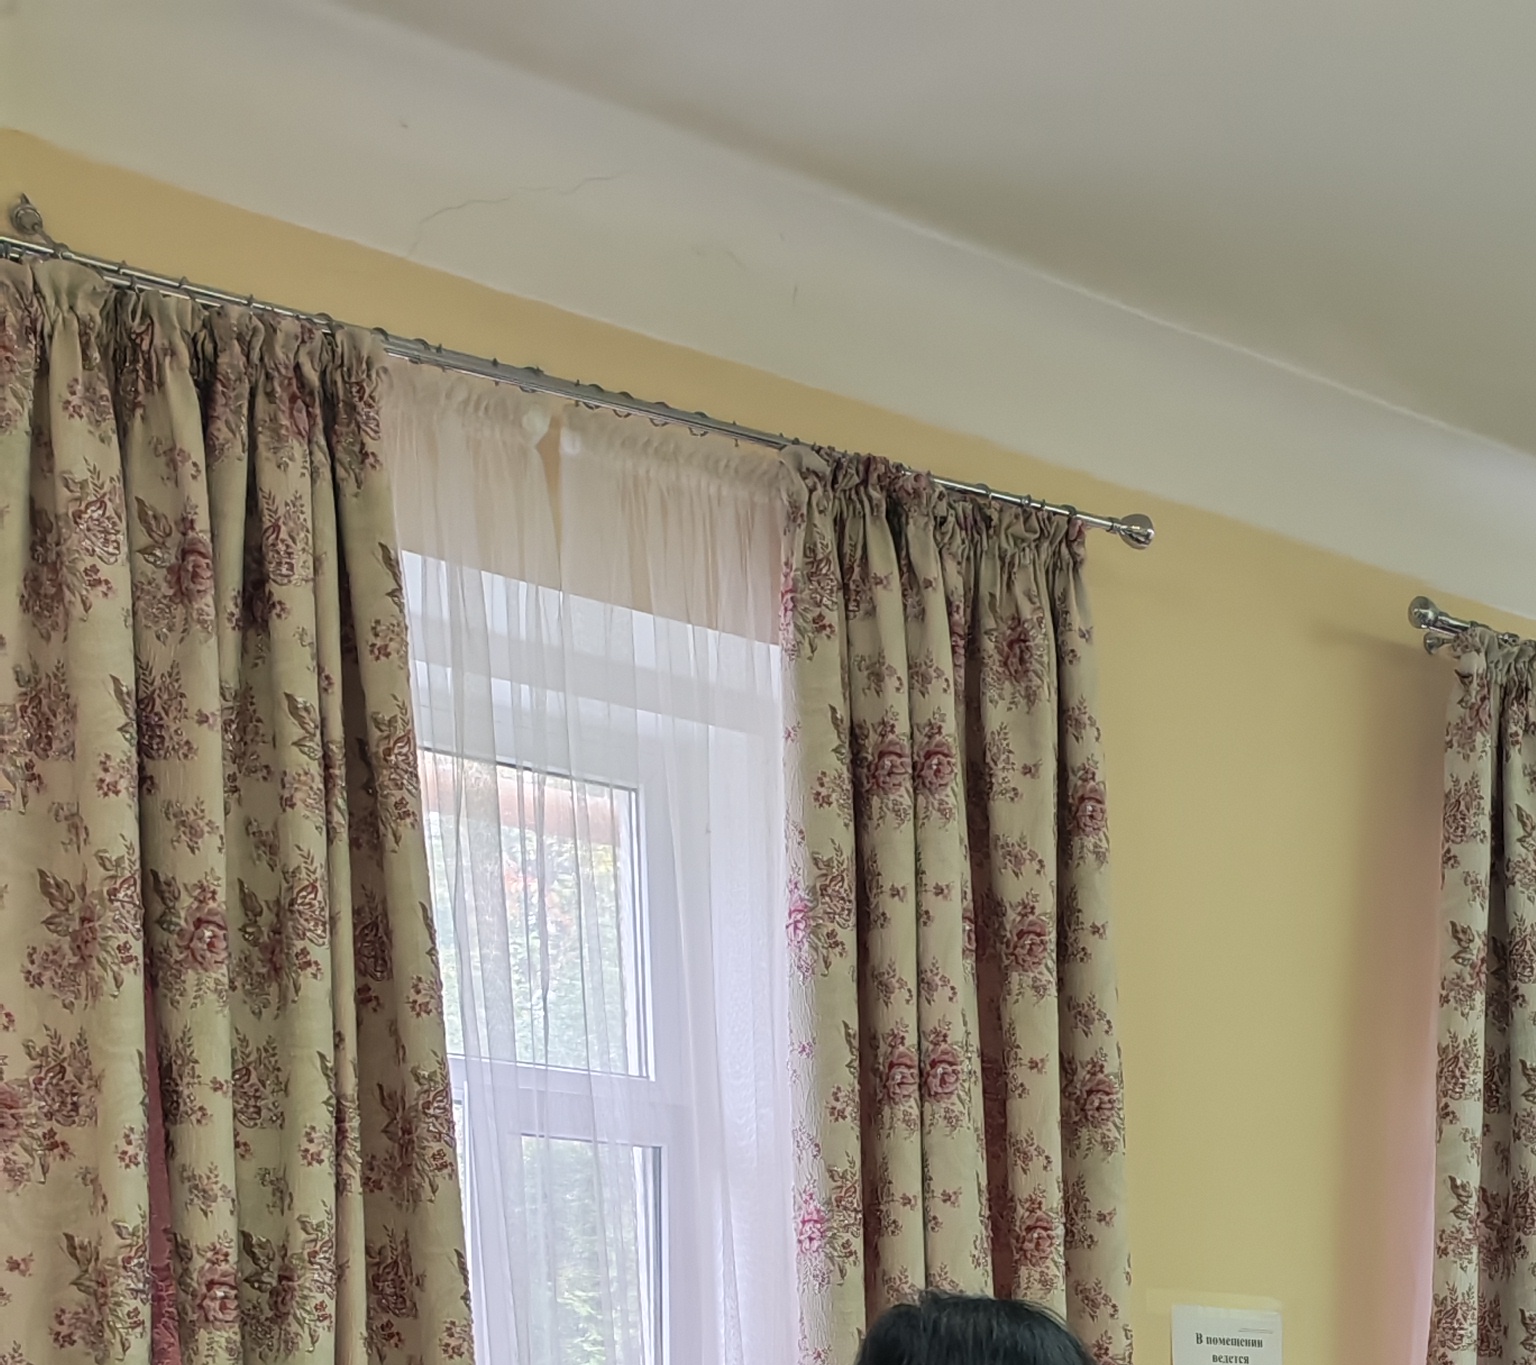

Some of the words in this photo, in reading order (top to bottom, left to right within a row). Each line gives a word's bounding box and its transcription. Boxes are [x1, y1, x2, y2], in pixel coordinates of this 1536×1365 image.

[1195, 1332, 1204, 1345] В
[1206, 1336, 1264, 1348] помещении
[1211, 1354, 1250, 1365] ведется
